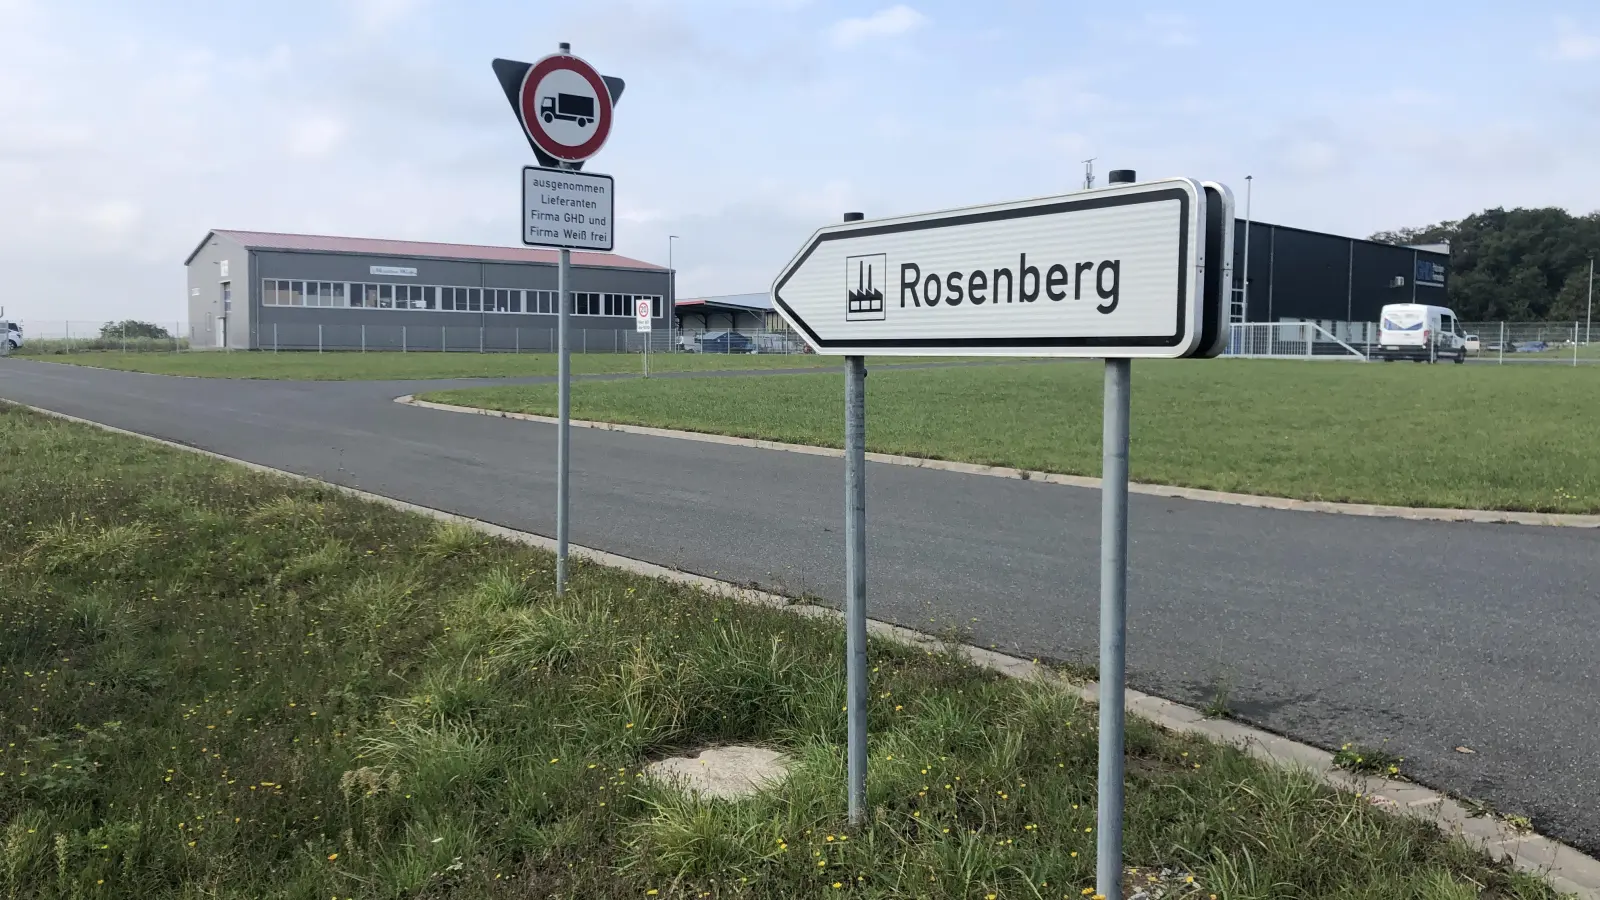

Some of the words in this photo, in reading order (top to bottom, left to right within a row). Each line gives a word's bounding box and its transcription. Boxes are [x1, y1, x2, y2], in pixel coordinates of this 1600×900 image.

[533, 179, 604, 194] ausgenommen
[541, 194, 596, 209] Lieferanten
[531, 210, 559, 222] Firma
[564, 213, 584, 223] GHD
[589, 217, 606, 226] und
[530, 226, 558, 237] Firma
[563, 229, 586, 240] Weiß
[591, 232, 607, 242] frei
[900, 252, 1121, 315] Rosenberg
